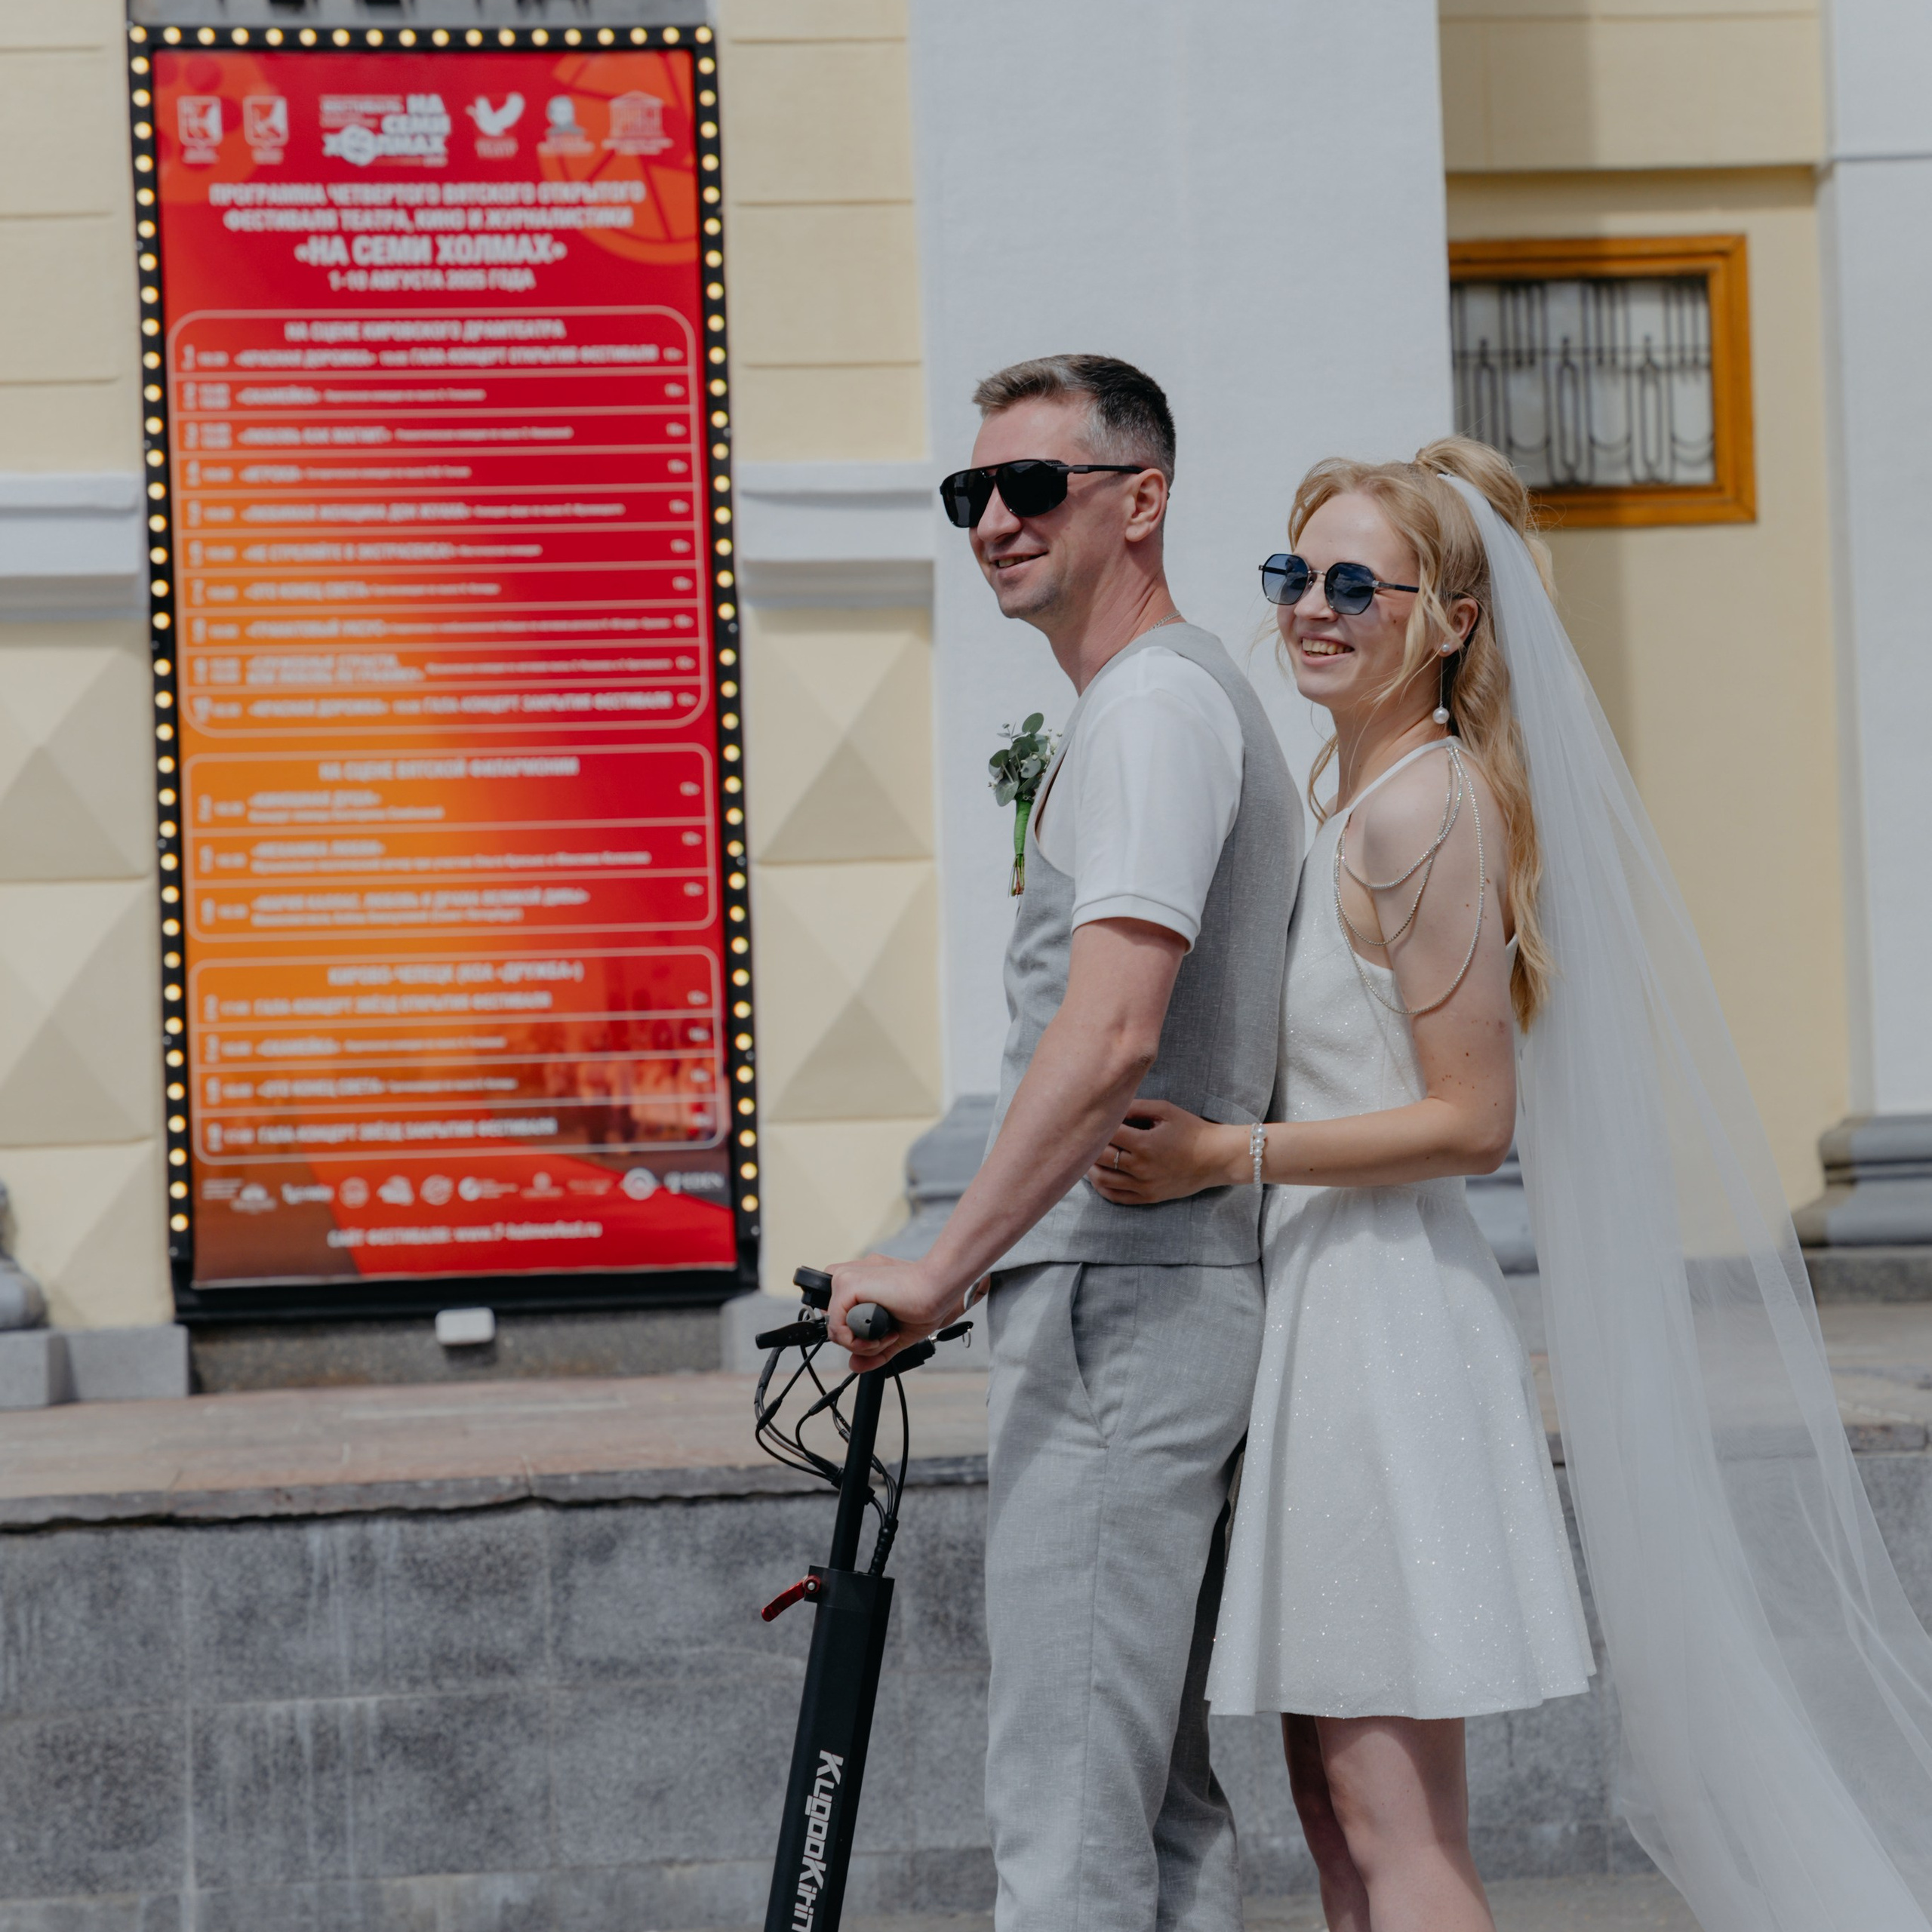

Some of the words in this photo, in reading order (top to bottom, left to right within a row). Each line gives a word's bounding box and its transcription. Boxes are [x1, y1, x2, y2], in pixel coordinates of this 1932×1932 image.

[352, 235, 432, 266] СЕМИ
[435, 233, 567, 265] ХОЛМАХ»
[790, 1749, 844, 1932] KugooKirin
